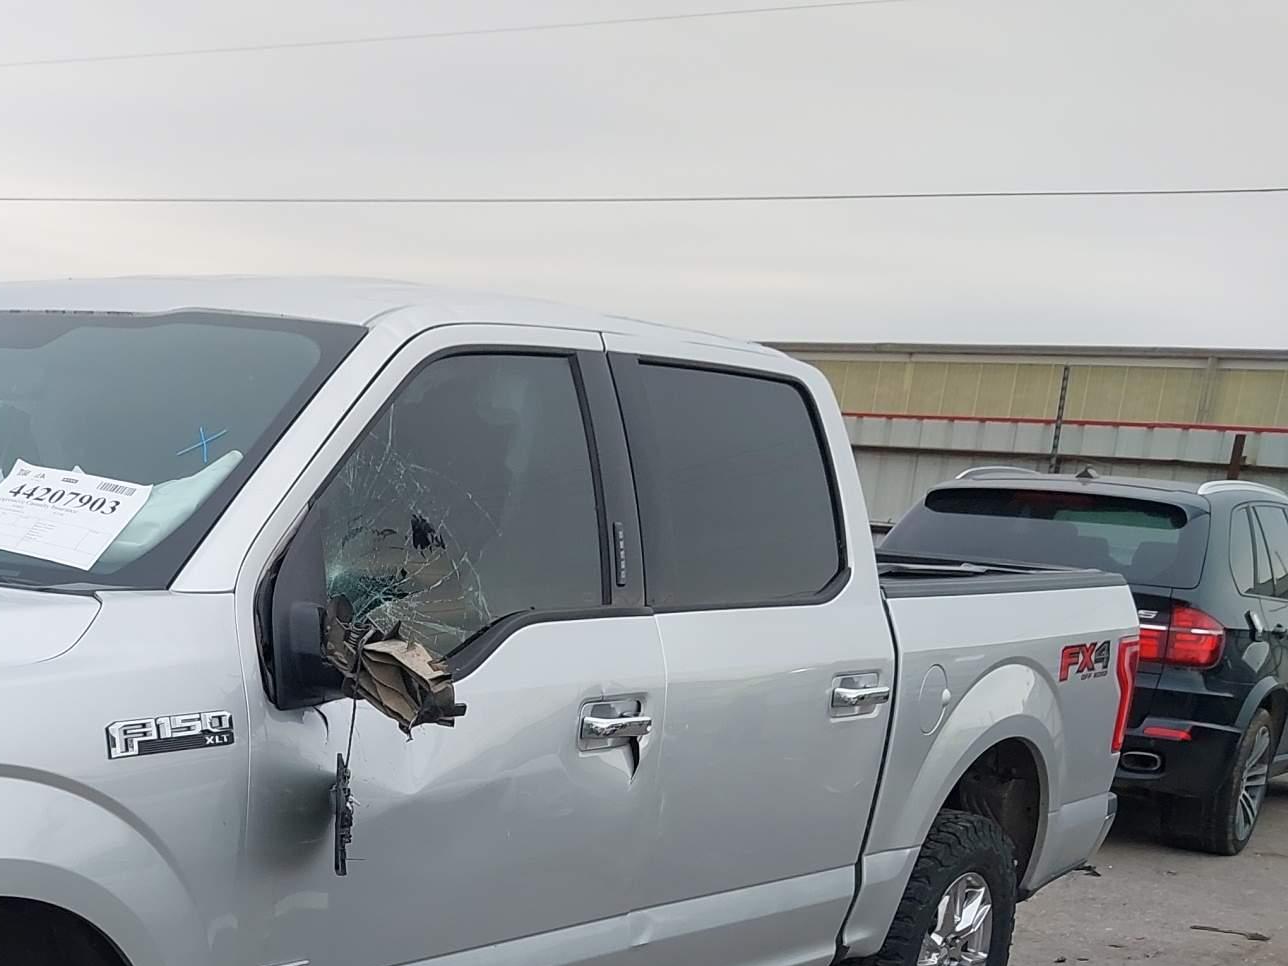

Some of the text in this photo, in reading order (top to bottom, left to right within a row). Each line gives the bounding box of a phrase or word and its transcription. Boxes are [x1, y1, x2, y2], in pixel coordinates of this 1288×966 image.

[9, 482, 121, 515] 44207903
[1059, 640, 1111, 682] FX4
[106, 709, 234, 759] F150
[205, 735, 230, 745] XLT
